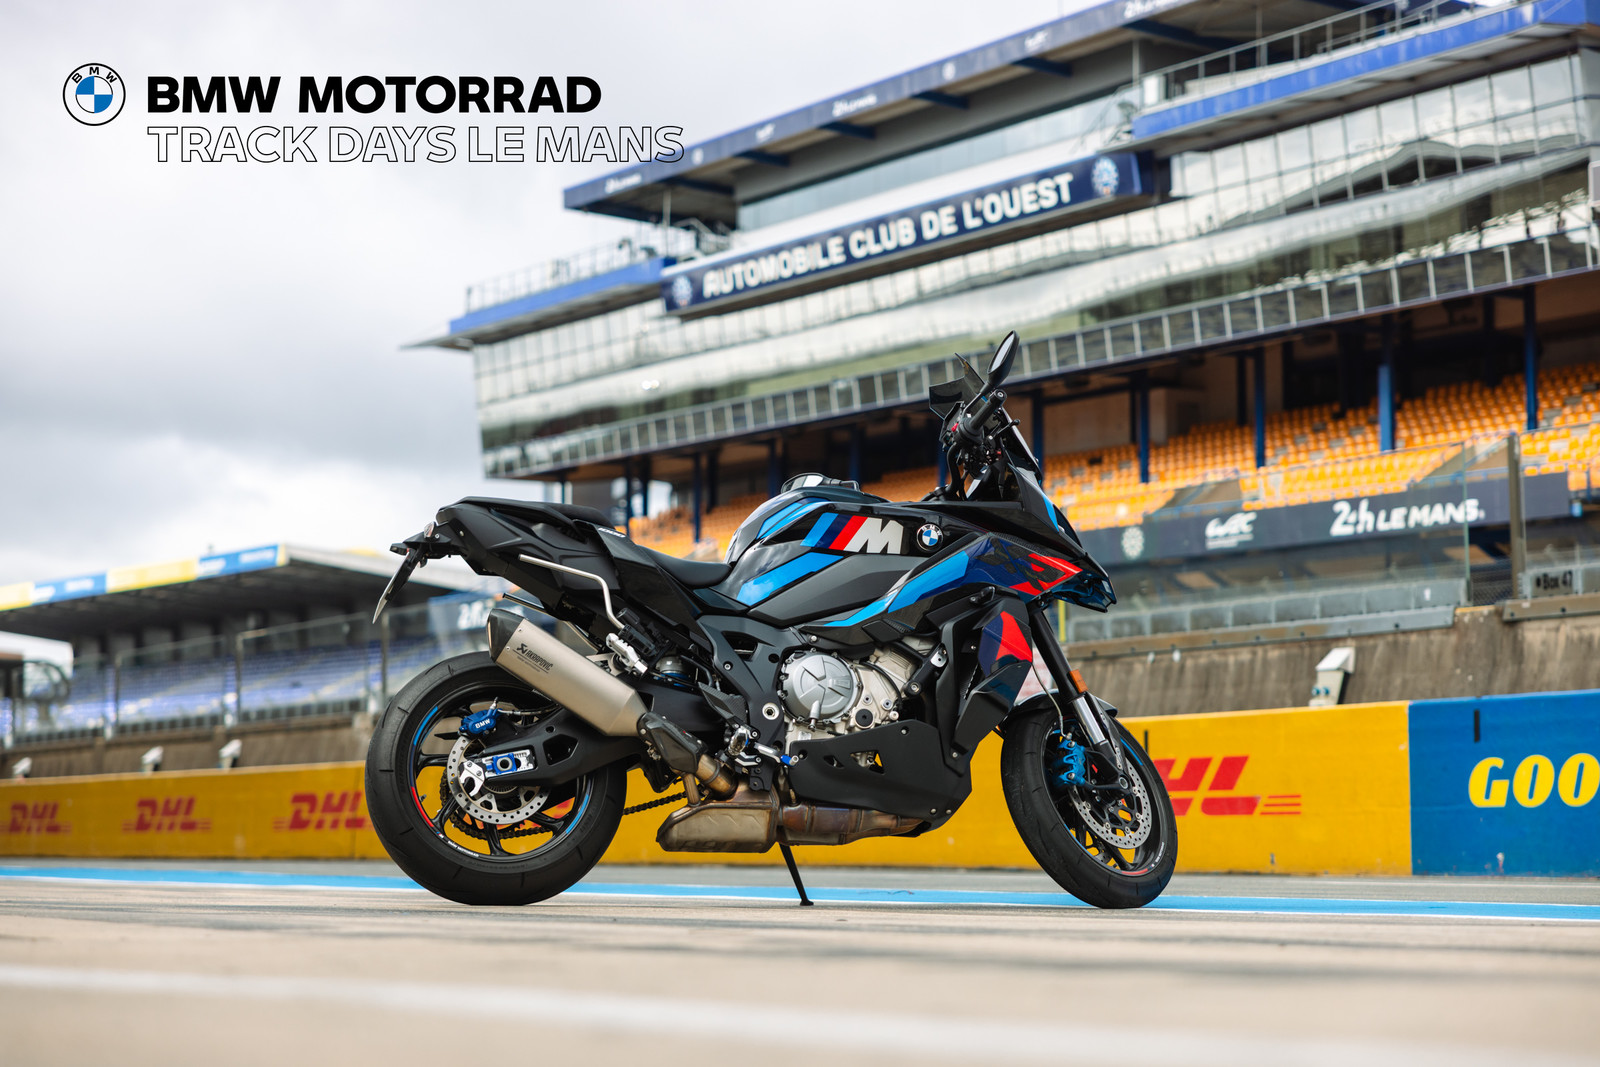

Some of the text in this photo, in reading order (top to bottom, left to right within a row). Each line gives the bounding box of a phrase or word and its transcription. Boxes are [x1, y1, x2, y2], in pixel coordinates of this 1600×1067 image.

[703, 172, 1074, 299] AUTOMOBILE CLUB DE L'OUEST
[843, 517, 904, 554] M
[1376, 507, 1408, 532] LE
[475, 718, 491, 729] BMW
[1153, 755, 1262, 817] HL
[1468, 752, 1600, 808] GOO
[9, 802, 62, 833] DHL
[135, 797, 197, 832] DHL
[288, 791, 366, 831] DHL
